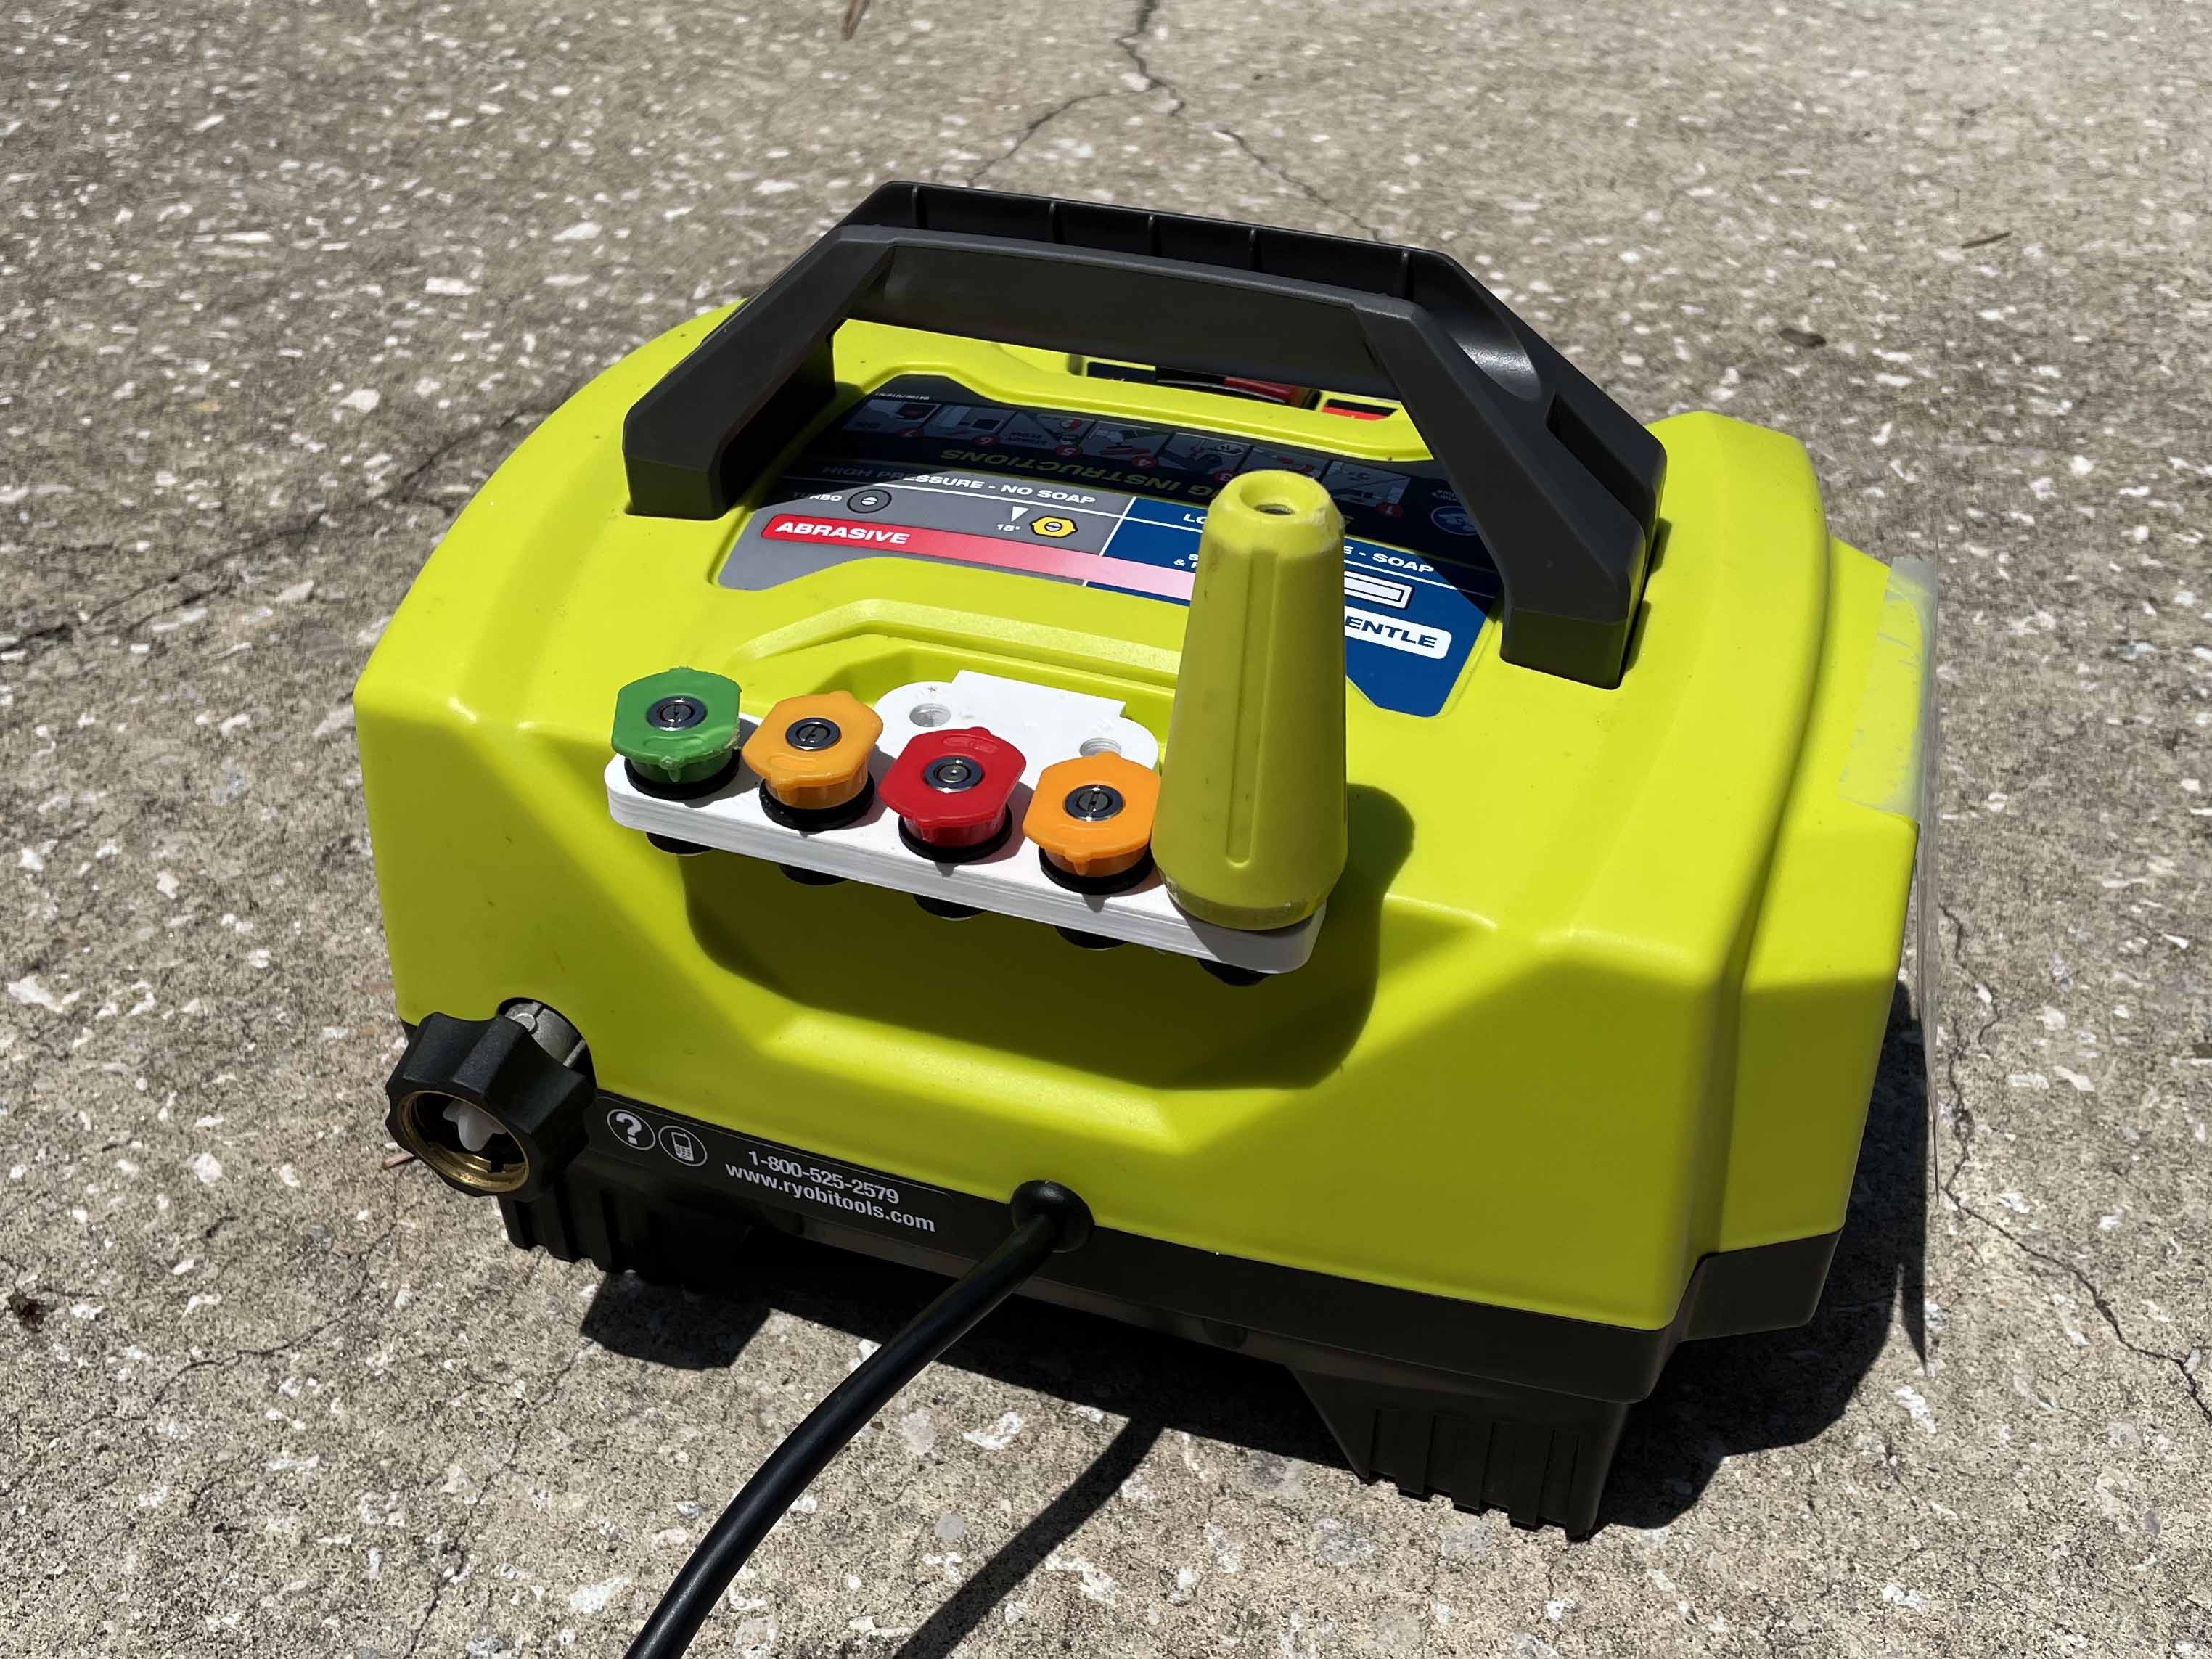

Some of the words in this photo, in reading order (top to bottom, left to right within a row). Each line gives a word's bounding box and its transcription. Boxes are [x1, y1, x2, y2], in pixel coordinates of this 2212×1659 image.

[822, 464, 872, 478] HIGH
[877, 470, 985, 489] PRESSURE
[1001, 483, 1033, 496] NO
[1038, 489, 1097, 506] SOAP
[941, 448, 1179, 492] INSTRUCTIONS
[792, 491, 843, 501] TURBO
[774, 521, 911, 544] ABRASIVE
[1183, 513, 1207, 525] LO
[1372, 552, 1435, 573] SOAP
[1345, 615, 1438, 649] ENTLE
[748, 1150, 900, 1205] 1-800-525-2579
[724, 1163, 935, 1232] www.ryobitools.com
